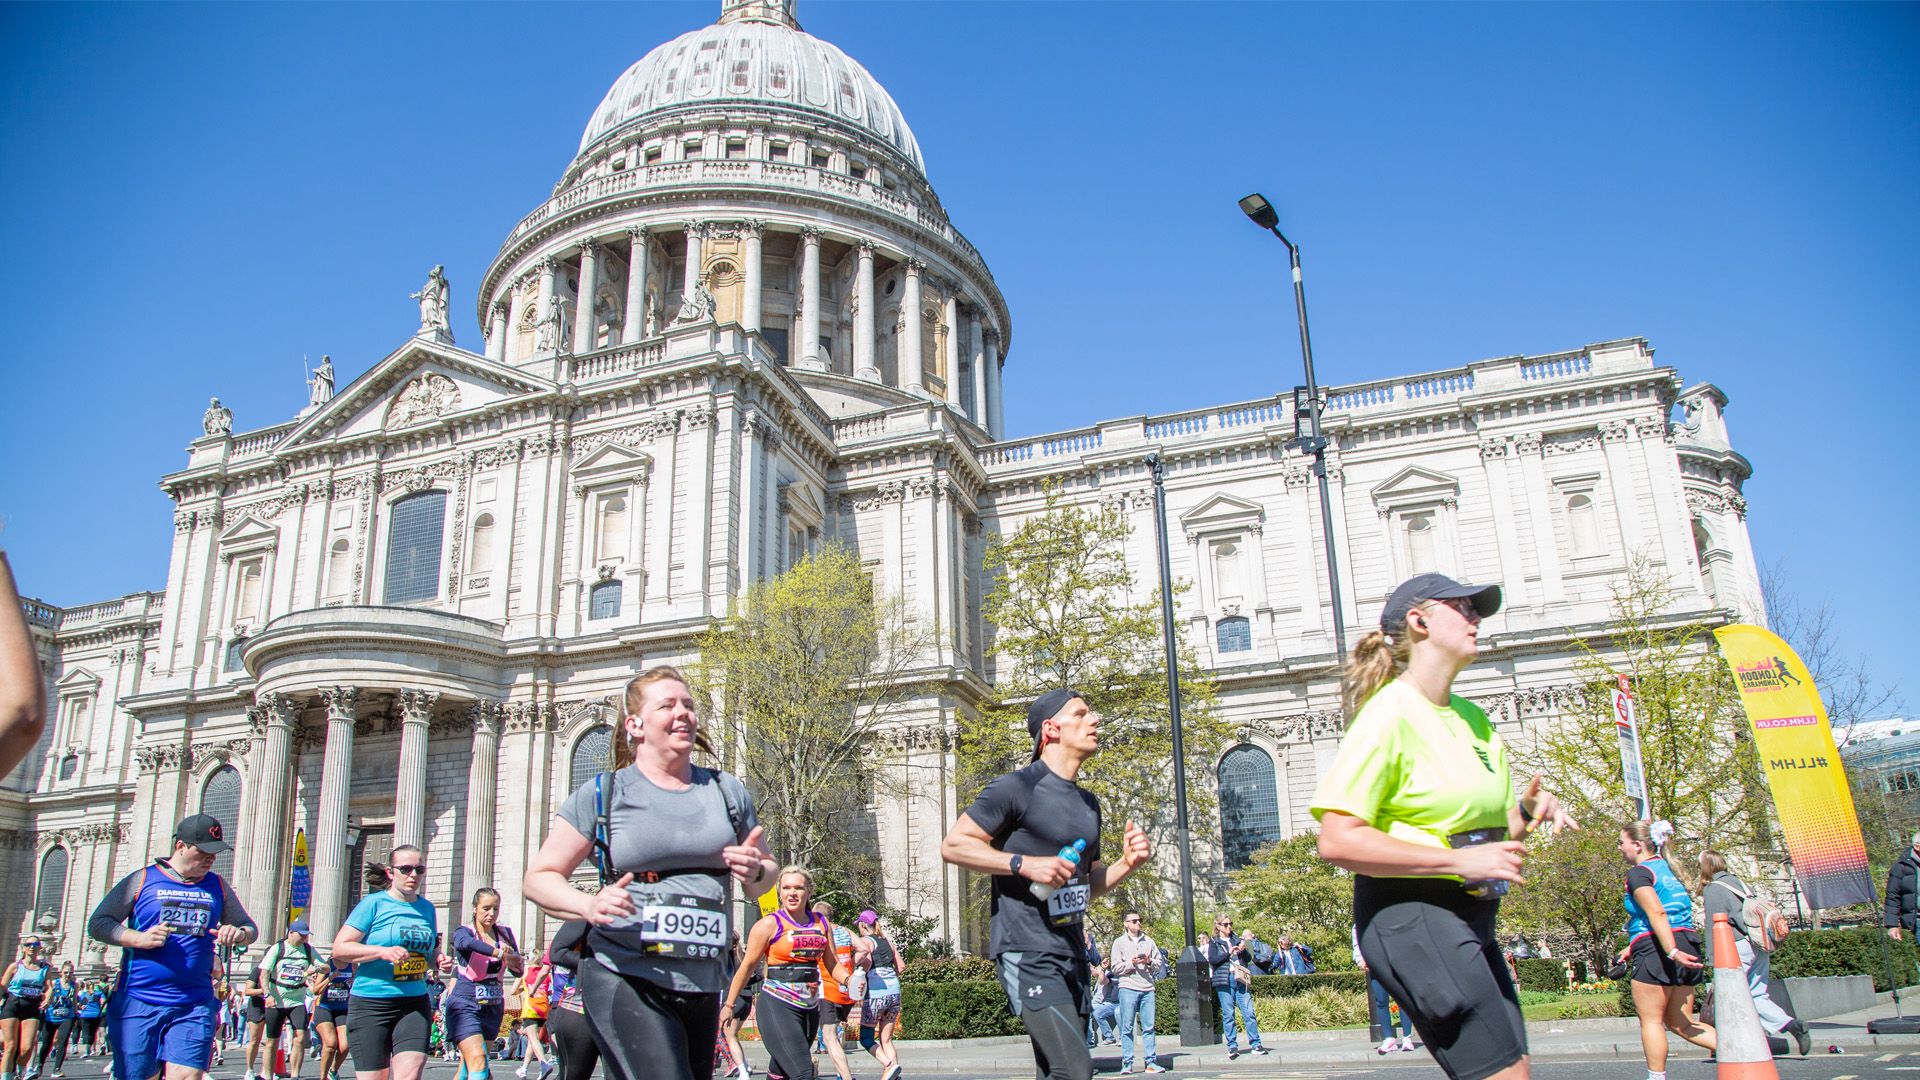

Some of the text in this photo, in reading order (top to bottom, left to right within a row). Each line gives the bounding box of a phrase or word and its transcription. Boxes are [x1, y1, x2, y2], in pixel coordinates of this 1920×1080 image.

[681, 896, 698, 906] MEL
[163, 910, 207, 924] 22143
[650, 913, 721, 939] 19954
[400, 930, 433, 941] KEW
